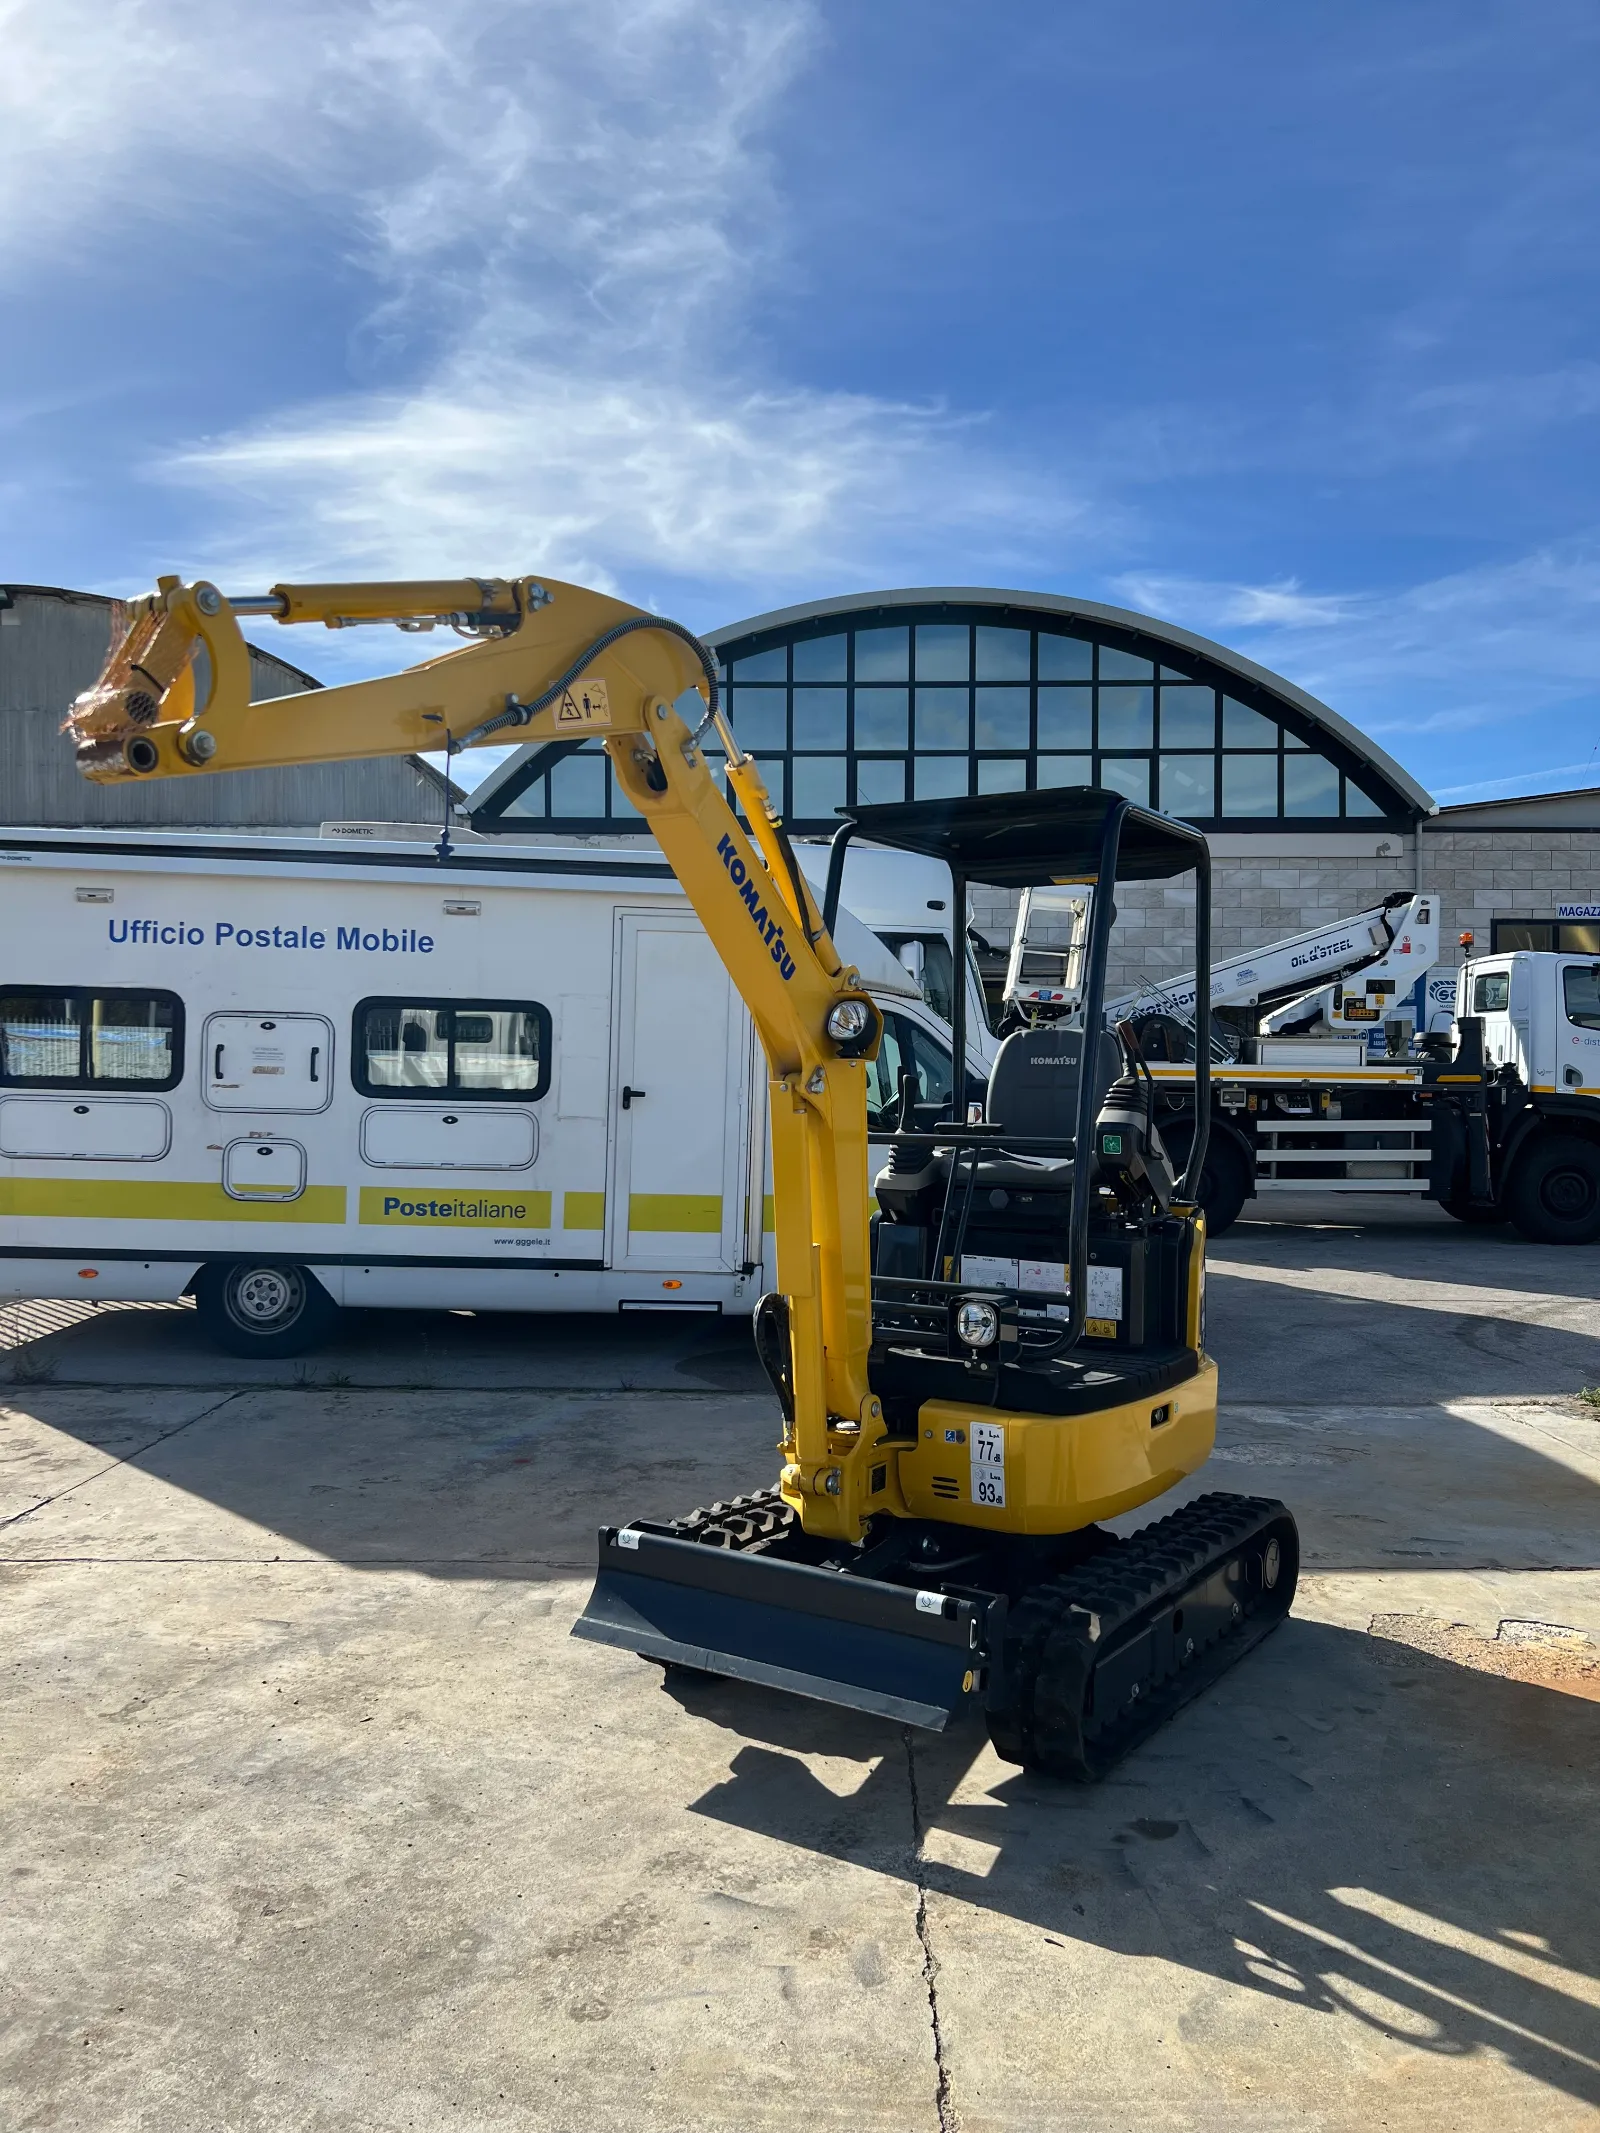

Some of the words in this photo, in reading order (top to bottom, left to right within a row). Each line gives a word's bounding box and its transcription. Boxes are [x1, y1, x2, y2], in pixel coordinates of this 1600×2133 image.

[716, 832, 797, 981] KOMATSU
[108, 920, 204, 945] Ufficio
[216, 923, 326, 949] Postale
[337, 927, 434, 953] Mobile
[1030, 1056, 1077, 1064] KOMATSU
[384, 1197, 526, 1219] Posteitaliane
[978, 1440, 994, 1460] 77
[979, 1482, 995, 1502] 93
